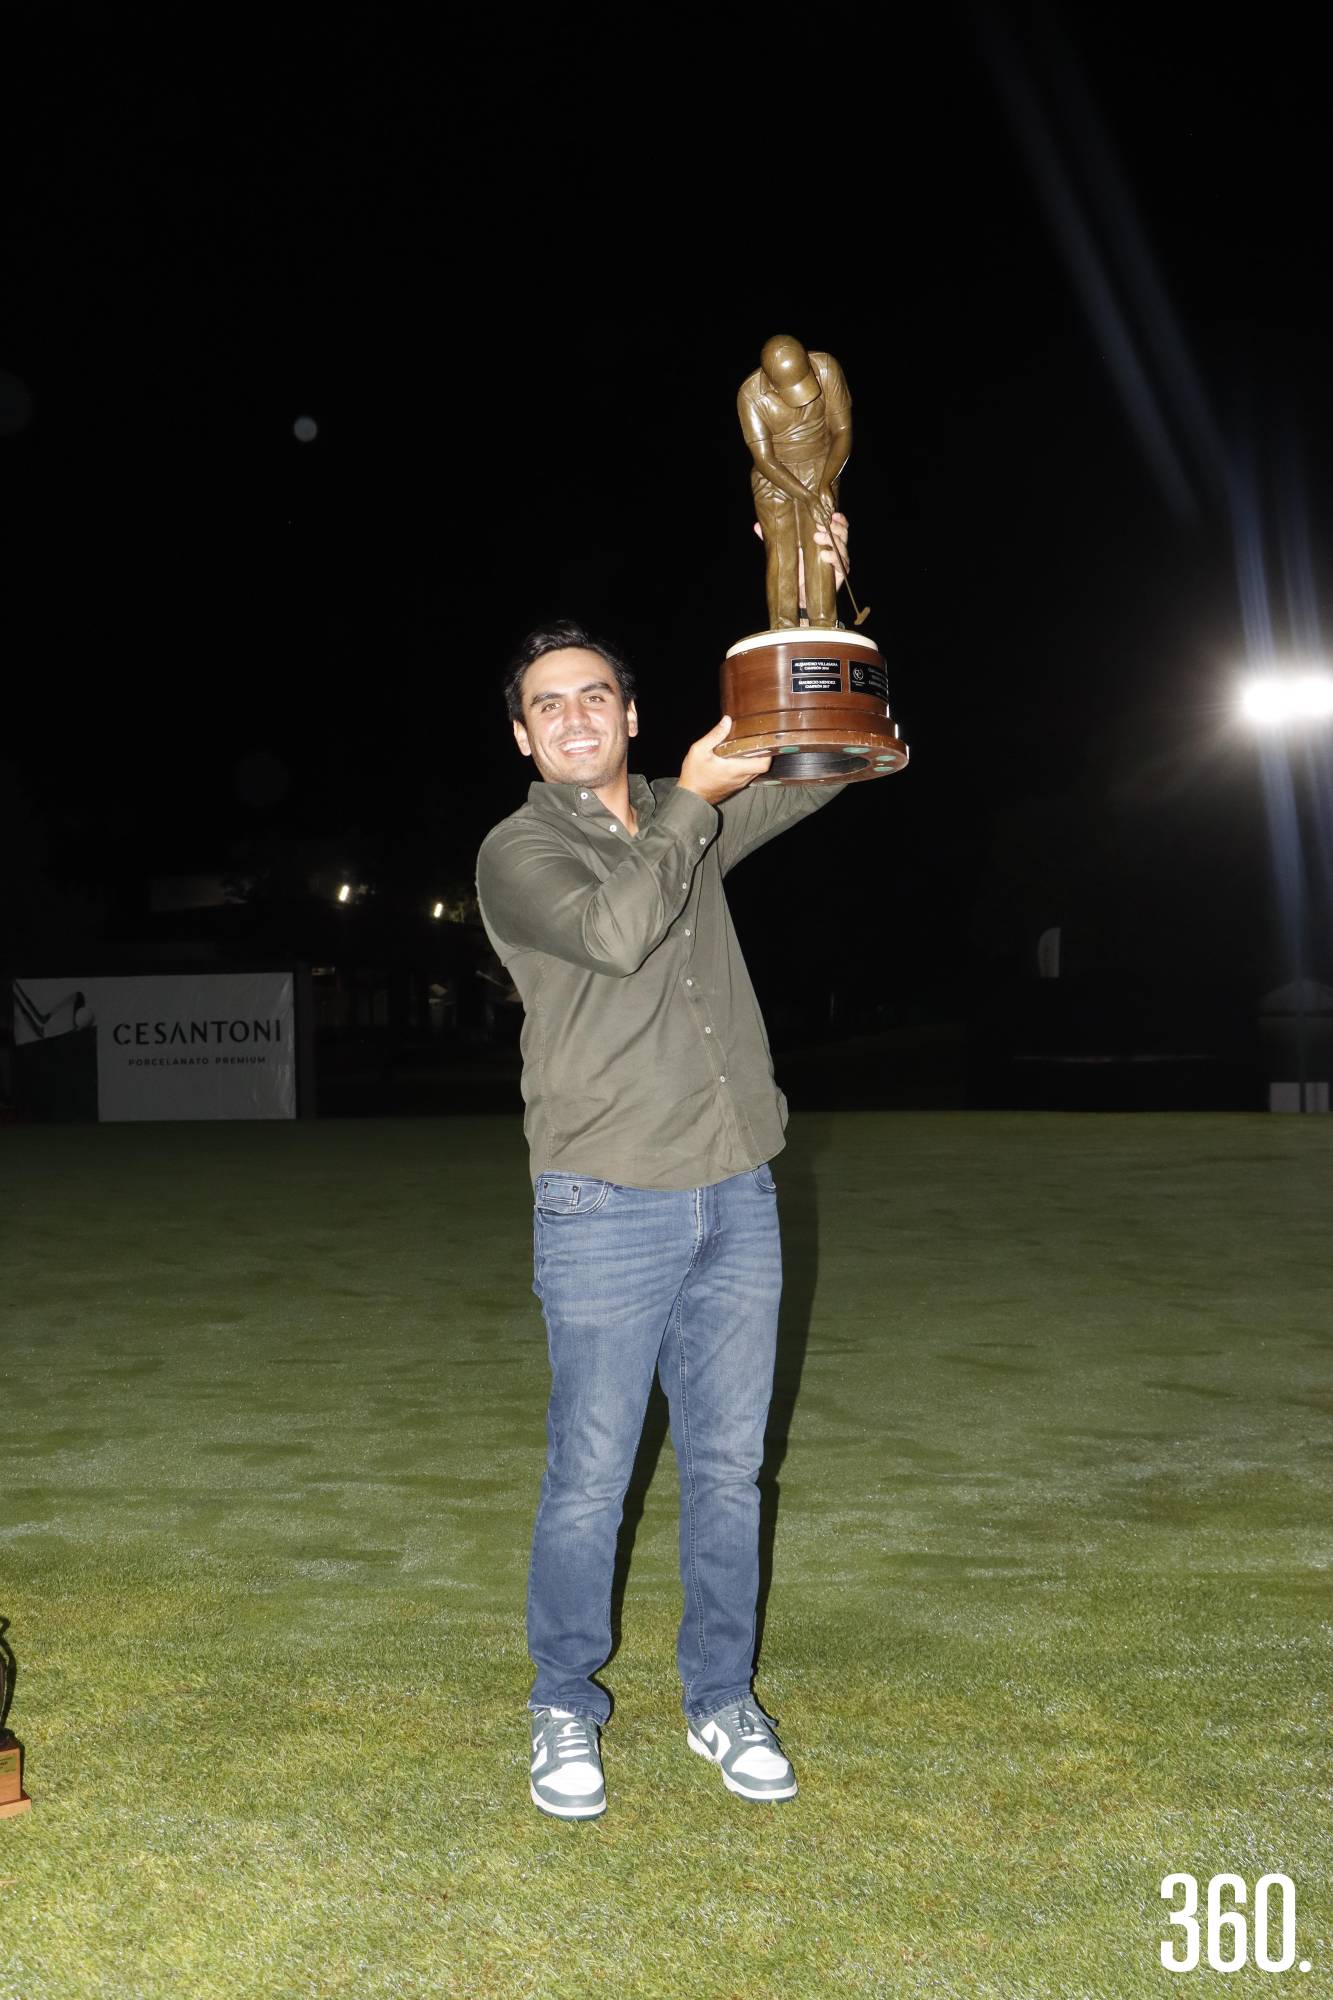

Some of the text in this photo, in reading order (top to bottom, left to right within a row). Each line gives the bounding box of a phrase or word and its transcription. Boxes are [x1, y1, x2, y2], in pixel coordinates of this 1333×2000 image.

[113, 1019, 281, 1045] CESANTONI
[128, 1056, 266, 1067] PORCELANATO PREMIUM
